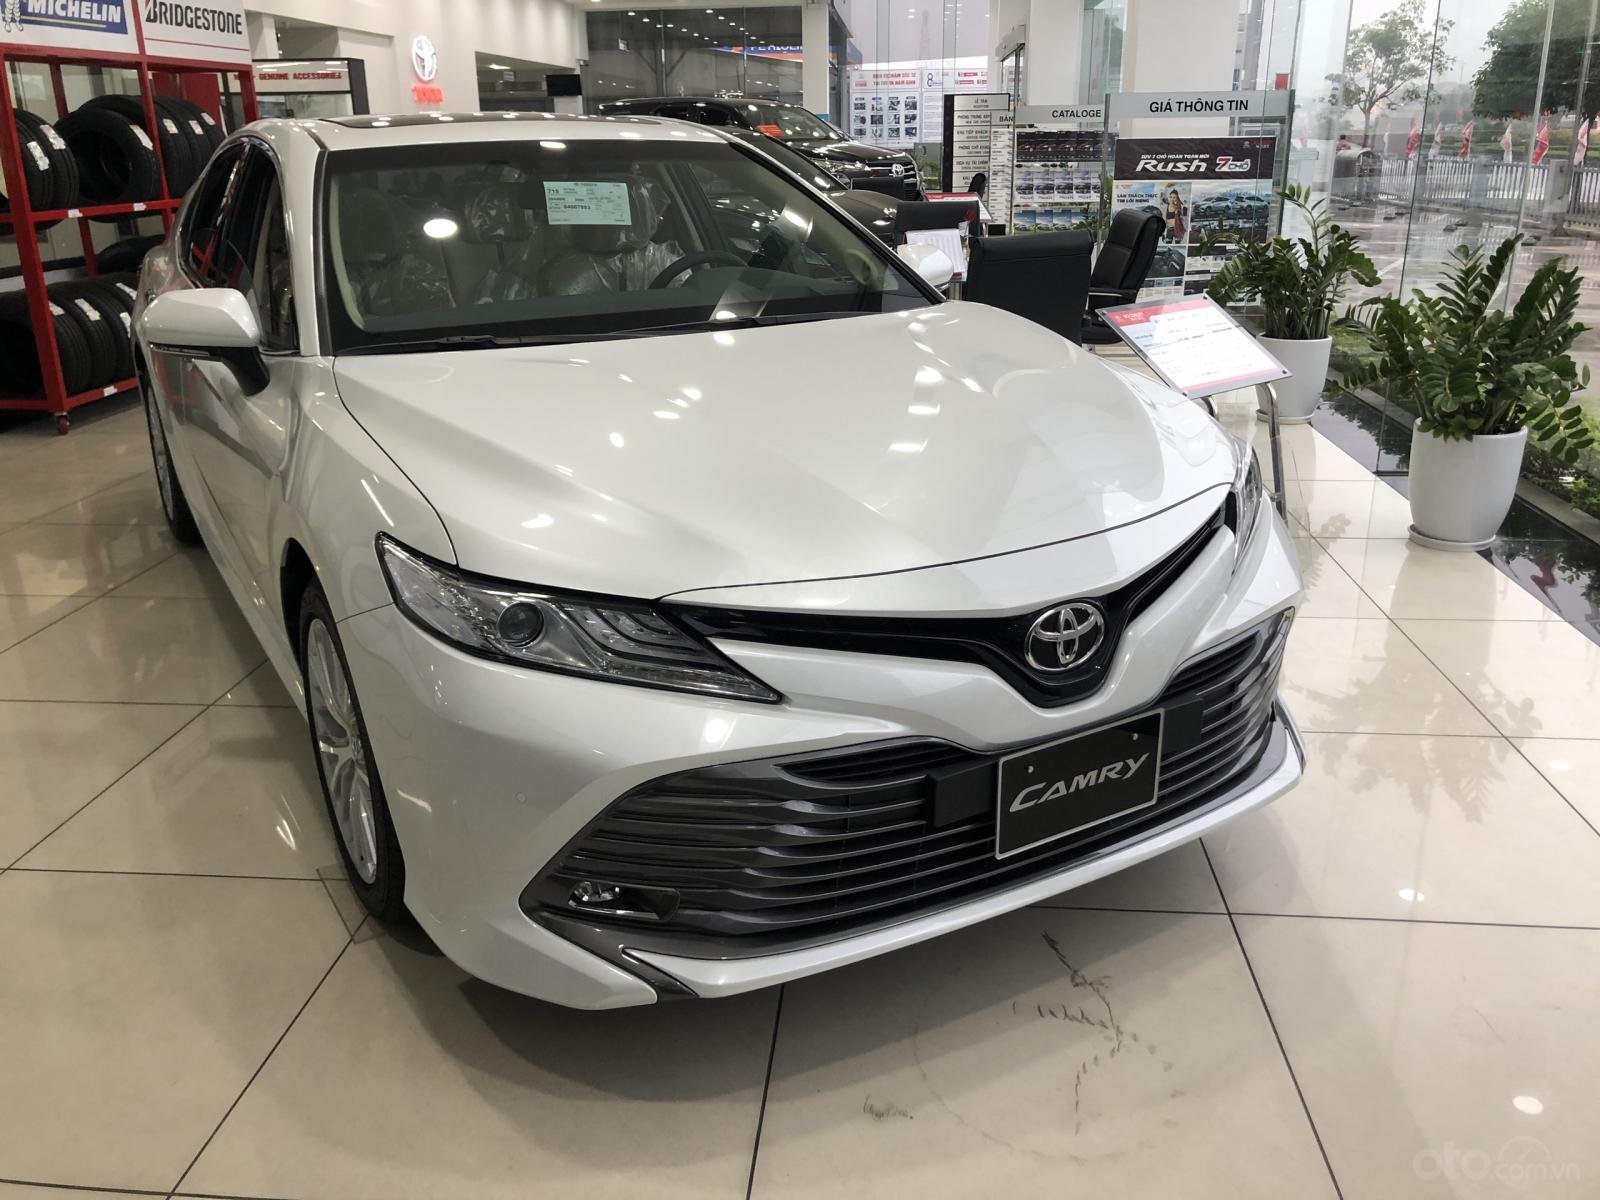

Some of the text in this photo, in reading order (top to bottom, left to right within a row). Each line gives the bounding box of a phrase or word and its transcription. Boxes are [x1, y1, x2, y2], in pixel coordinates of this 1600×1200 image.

[27, 0, 122, 23] MICHELIN
[146, 0, 243, 35] BRIDGESTONE
[259, 72, 288, 80] GENUINE
[293, 72, 342, 80] ACCESSORIES
[1149, 97, 1249, 113] GIÁ THÔNG TIN
[1051, 109, 1102, 118] CATALOGE
[1135, 159, 1208, 172] Rush
[1009, 752, 1150, 812] CAMRY
